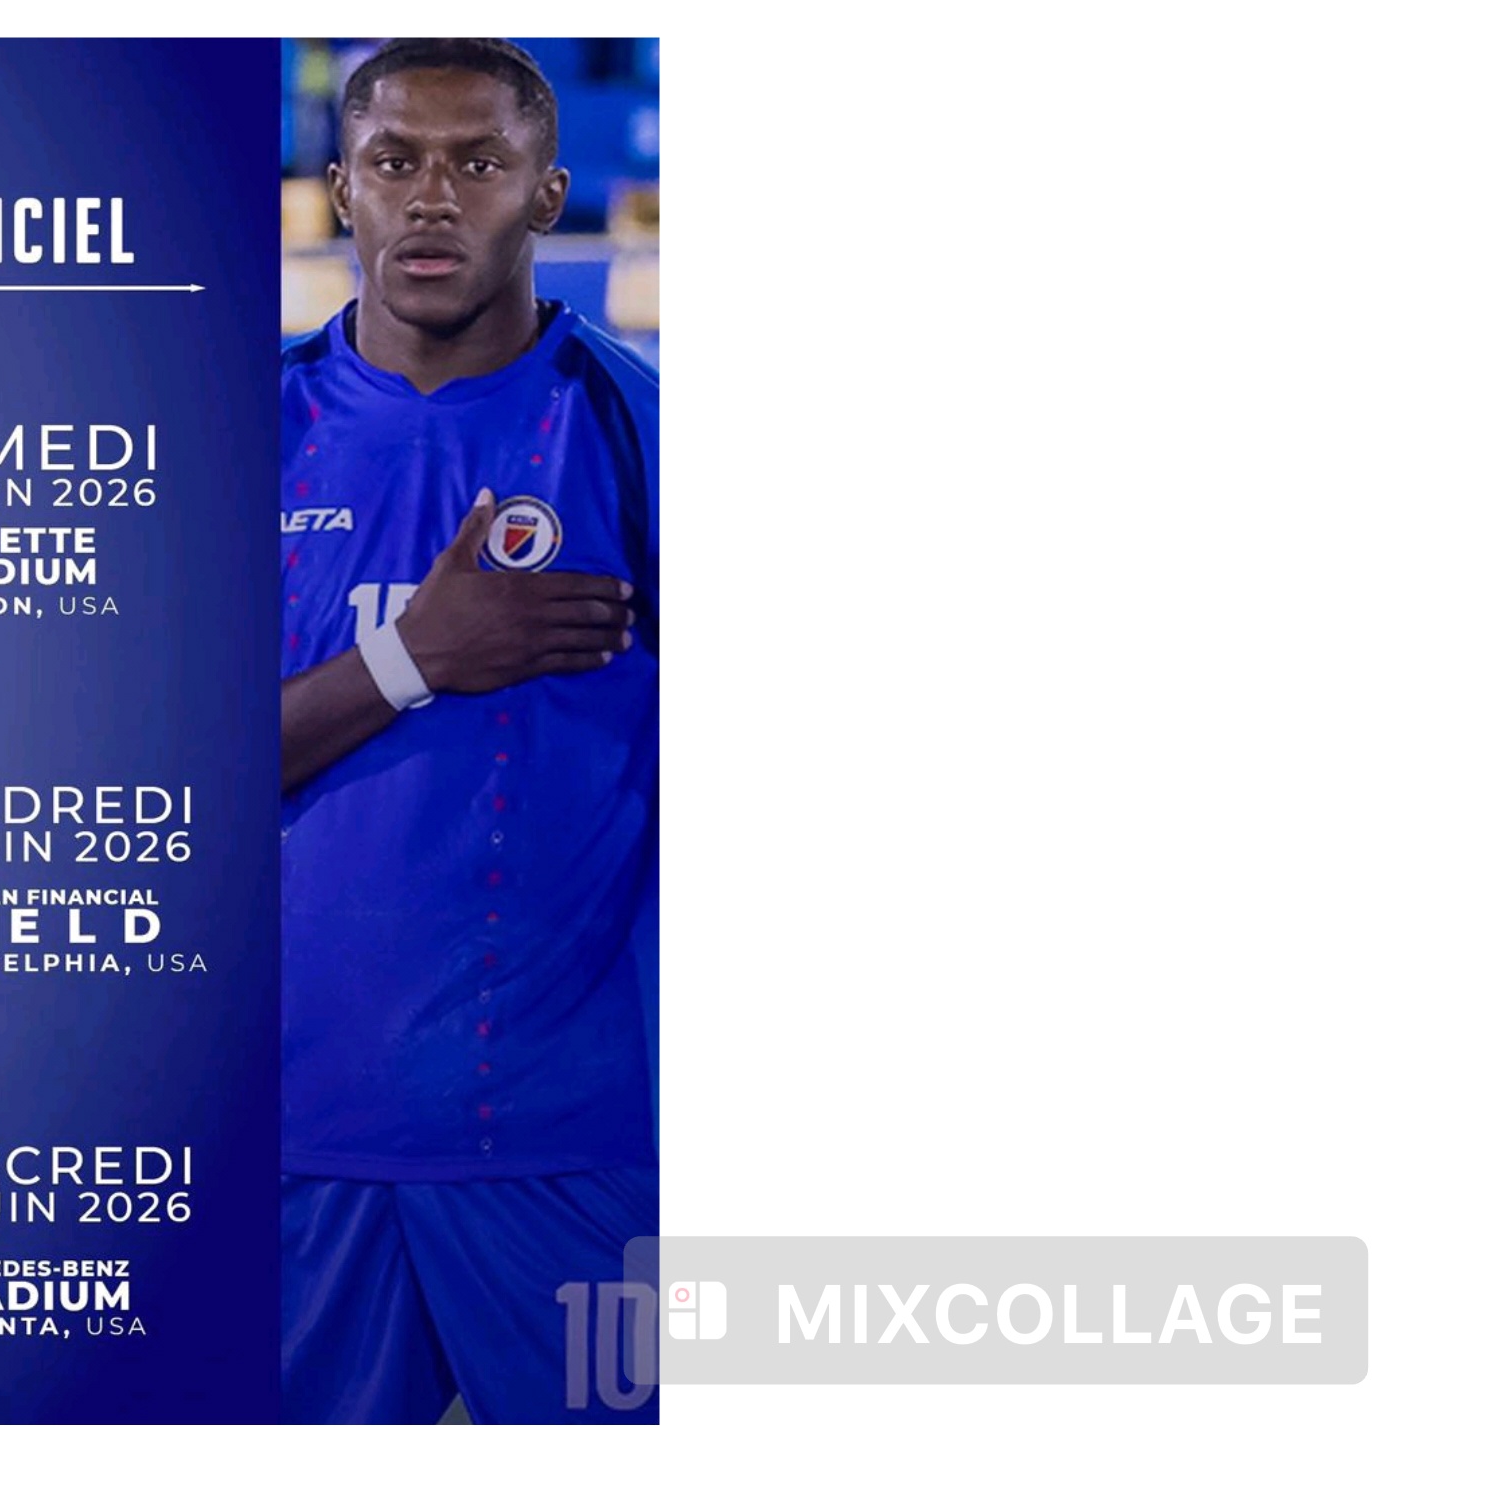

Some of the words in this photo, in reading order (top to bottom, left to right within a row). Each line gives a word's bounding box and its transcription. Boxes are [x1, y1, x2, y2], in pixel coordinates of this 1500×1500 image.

[52, 478, 156, 507] 2026
[59, 596, 119, 615] USA
[74, 830, 191, 863] 2026
[27, 889, 159, 906] FINANCIAL
[148, 953, 208, 973] USA
[74, 1191, 191, 1223] 2026
[87, 1317, 146, 1336] USA
[556, 1281, 660, 1410] 10
